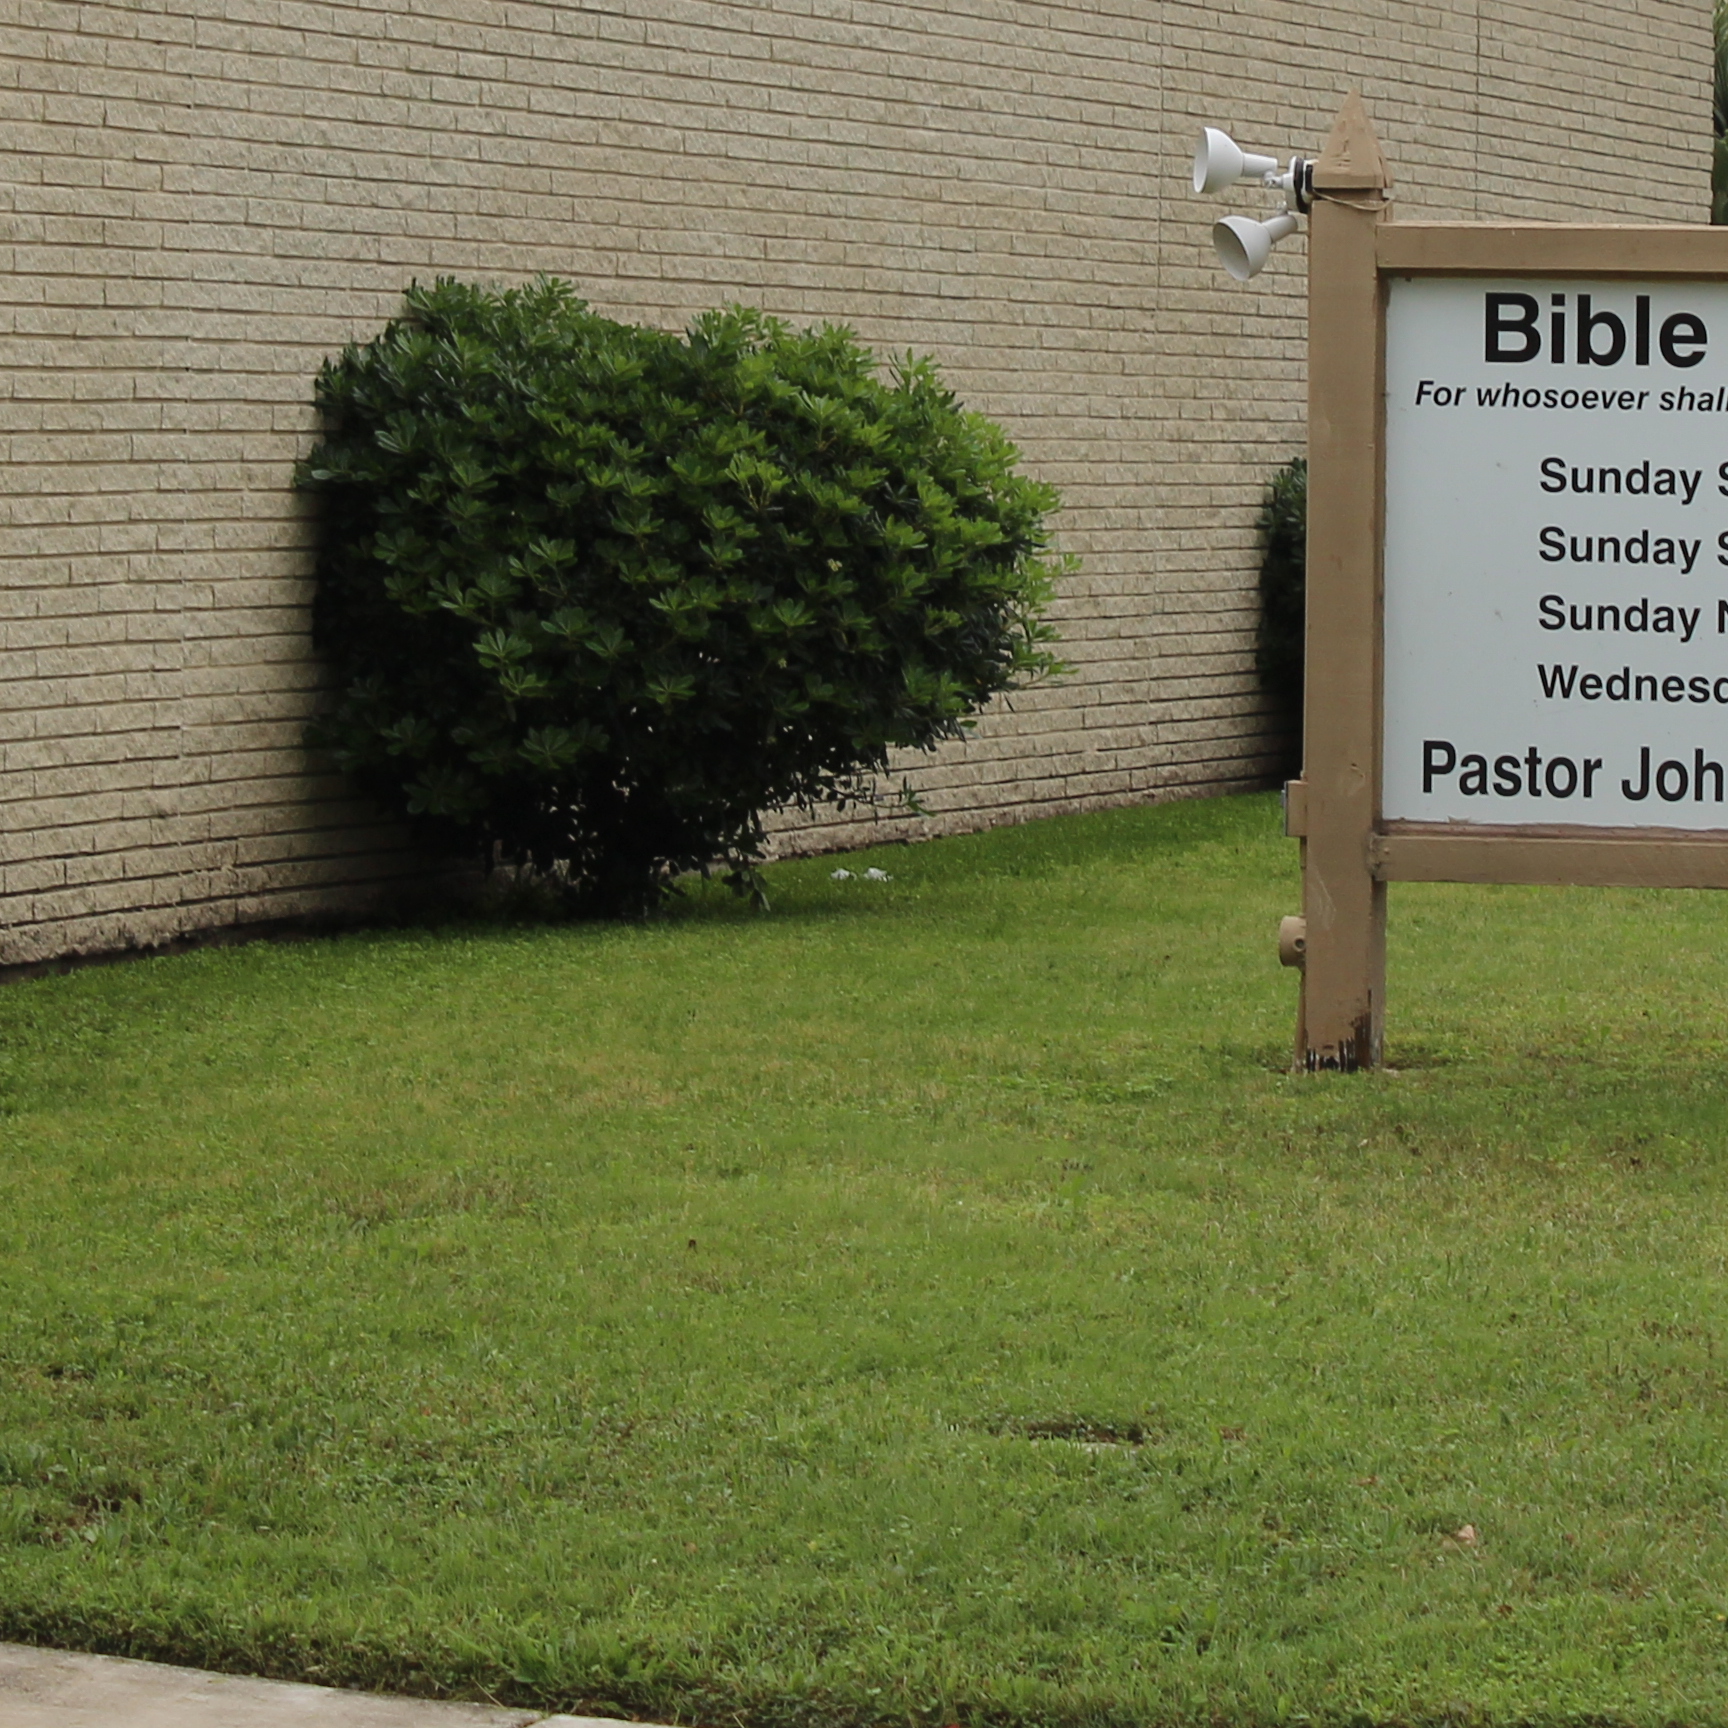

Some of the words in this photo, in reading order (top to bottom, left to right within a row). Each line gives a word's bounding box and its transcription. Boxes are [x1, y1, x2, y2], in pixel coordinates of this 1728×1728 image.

[1484, 291, 1708, 369] Bible
[1415, 380, 1467, 407] For
[1476, 382, 1650, 411] whosoever
[1540, 457, 1702, 506] Sunday
[1539, 526, 1702, 575] Sunday
[1538, 594, 1701, 643] Sunday
[1422, 740, 1603, 799] Pastor
